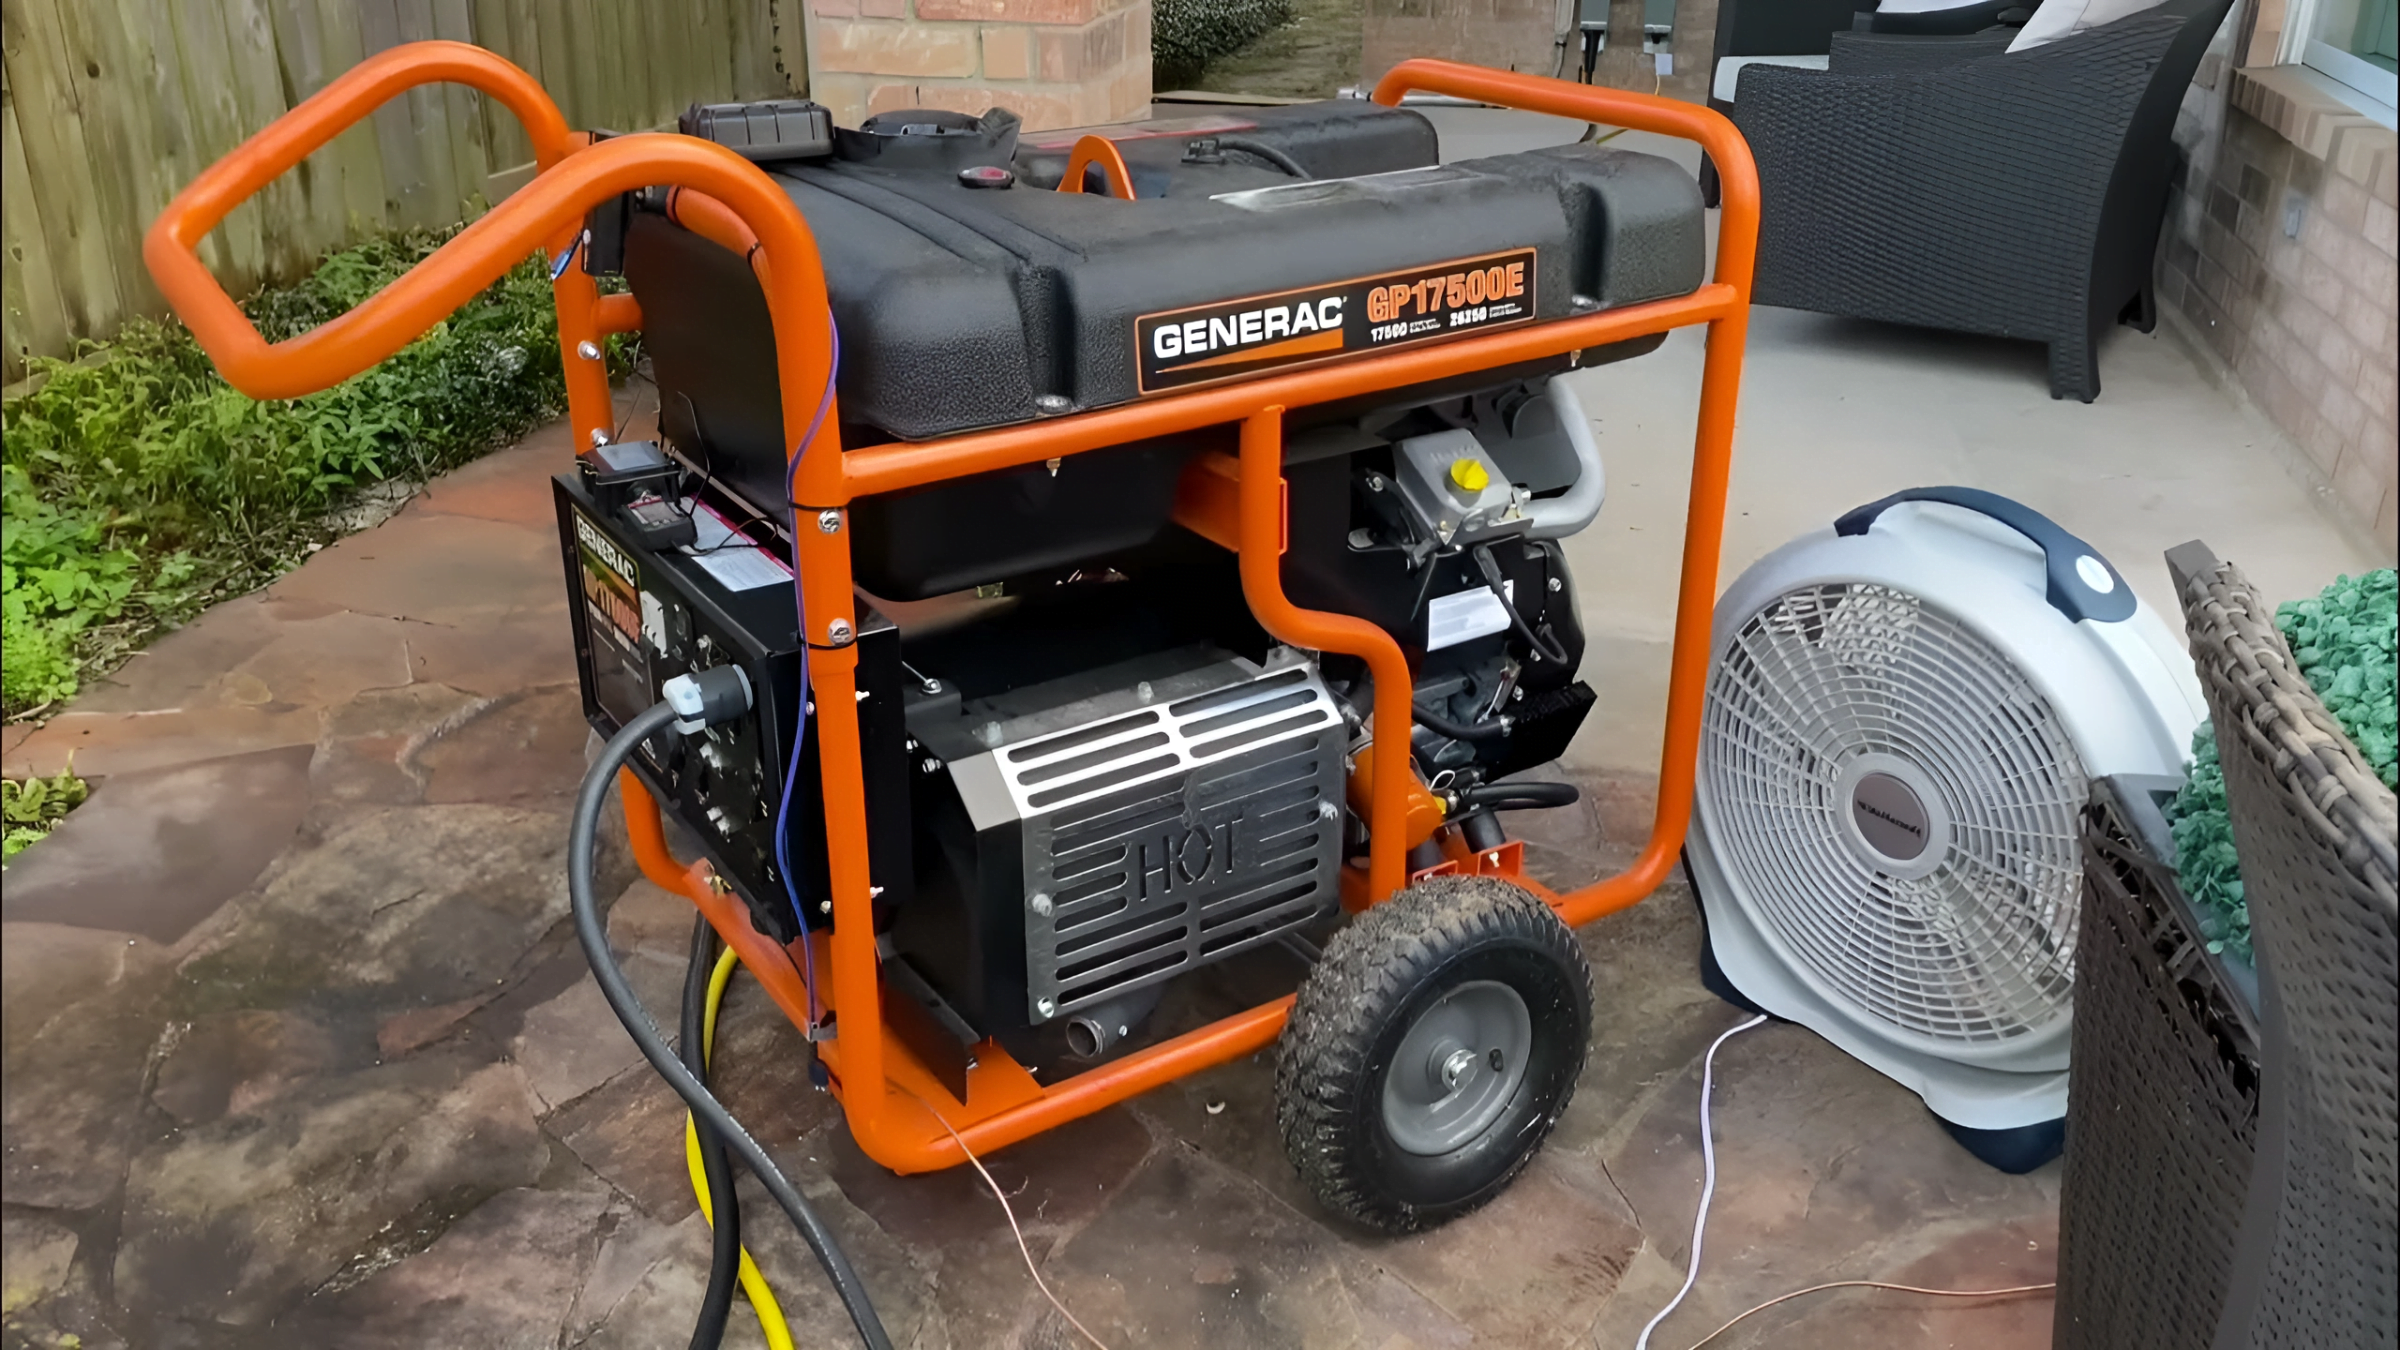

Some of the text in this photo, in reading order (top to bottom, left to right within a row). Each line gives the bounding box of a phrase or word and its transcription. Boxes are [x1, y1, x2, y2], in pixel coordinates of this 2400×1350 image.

[1366, 261, 1525, 324] GP17500E
[1153, 296, 1344, 359] GENERAC
[1138, 813, 1244, 902] HOT
